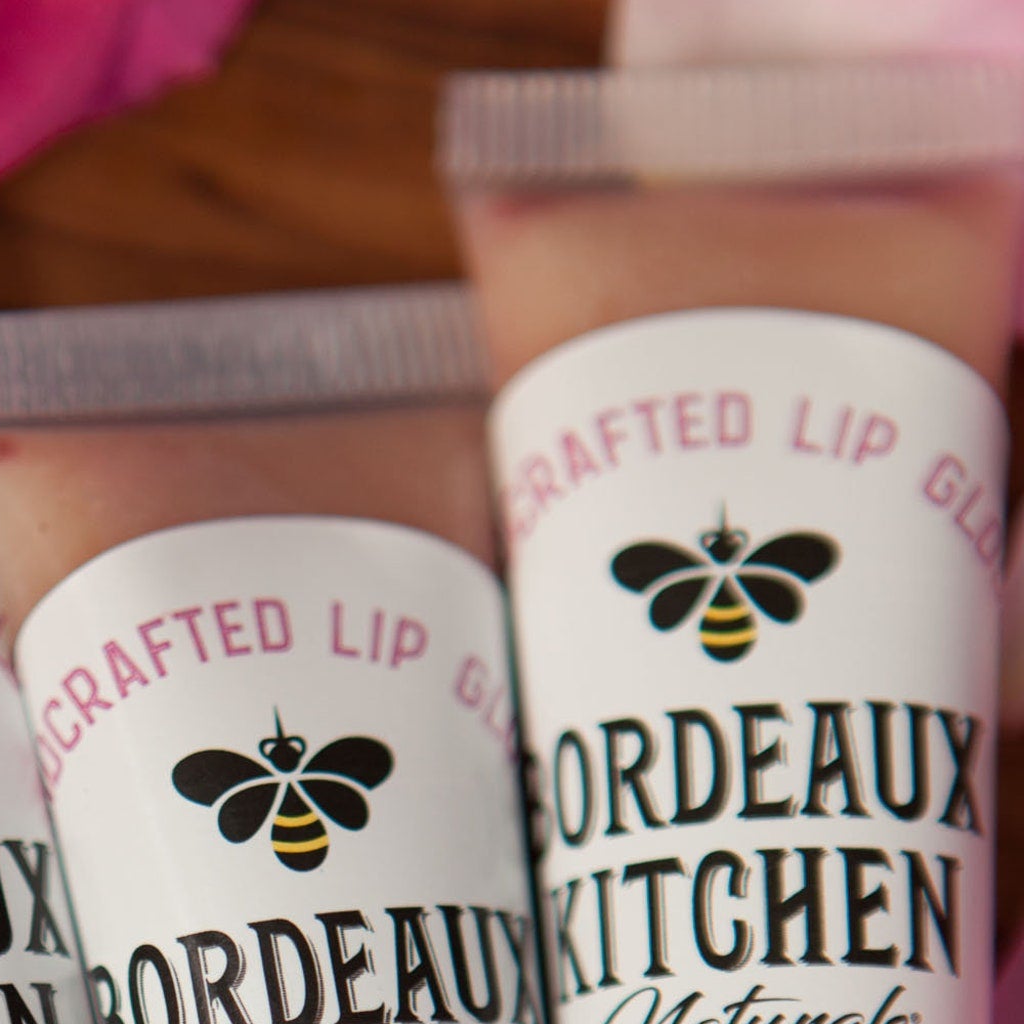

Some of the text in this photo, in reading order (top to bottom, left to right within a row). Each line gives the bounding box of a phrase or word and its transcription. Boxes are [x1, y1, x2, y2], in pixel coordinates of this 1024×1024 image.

[791, 395, 898, 466] LIP
[330, 600, 428, 669] LIP
[549, 847, 964, 1003] KITCHEN
